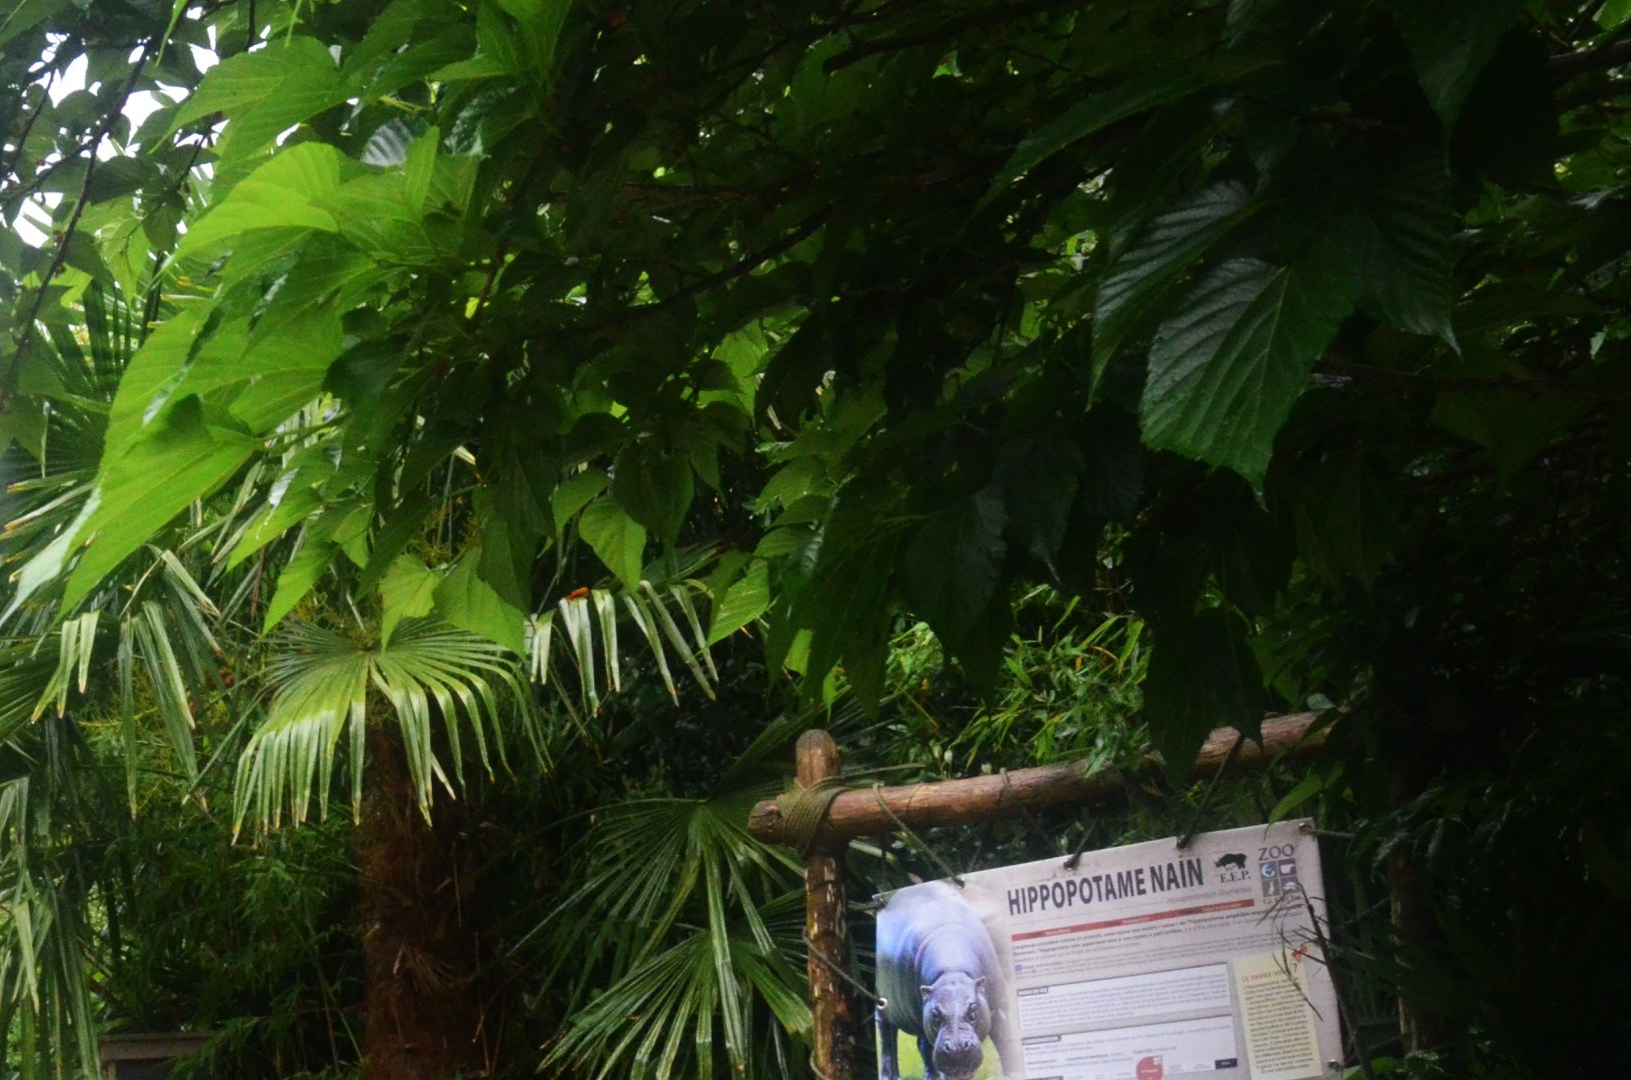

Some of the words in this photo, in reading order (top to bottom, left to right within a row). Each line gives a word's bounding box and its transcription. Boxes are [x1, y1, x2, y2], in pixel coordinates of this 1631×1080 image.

[1258, 844, 1294, 861] ZOO
[1007, 868, 1146, 915] HIPPOPOTAME
[1150, 857, 1204, 893] NAIN
